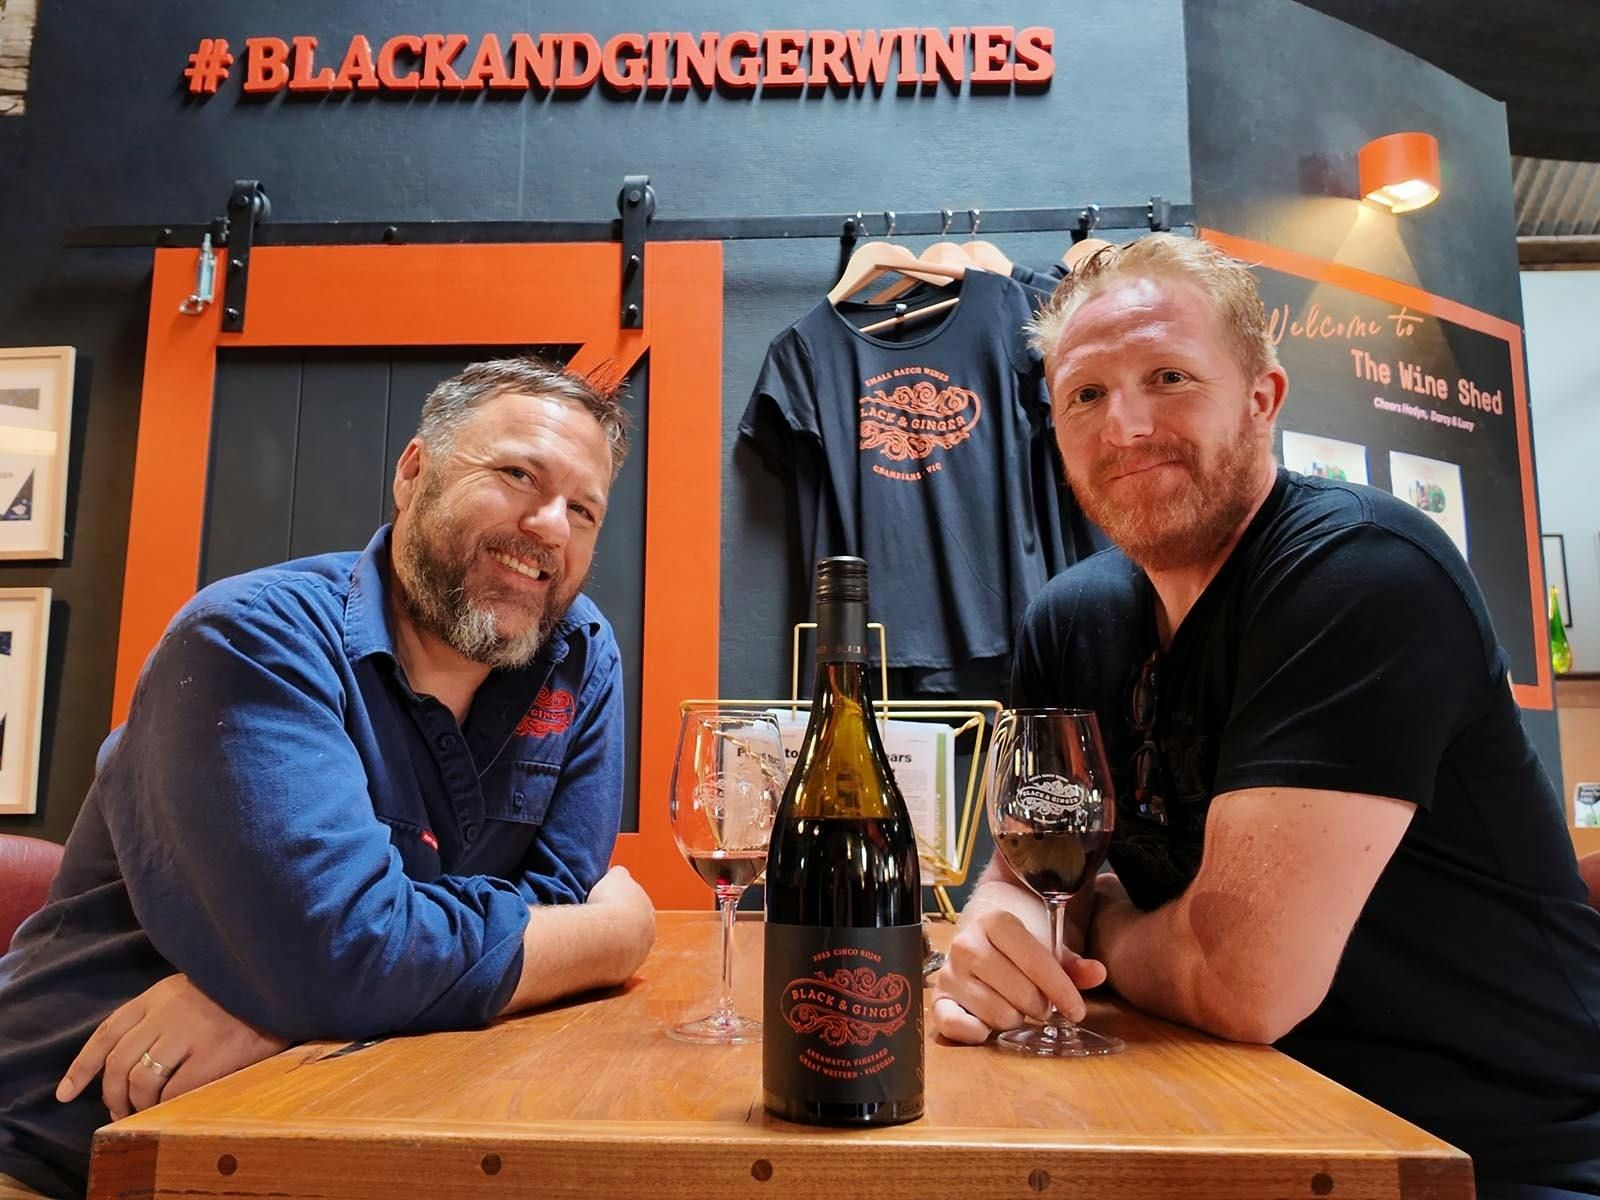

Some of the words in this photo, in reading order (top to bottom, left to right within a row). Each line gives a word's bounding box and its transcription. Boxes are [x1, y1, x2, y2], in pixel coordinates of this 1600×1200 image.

[1388, 306, 1424, 337] to
[865, 371, 892, 387] SMALL
[894, 367, 922, 377] BATCH
[924, 368, 949, 382] WINES
[1351, 349, 1391, 384] The
[1399, 360, 1448, 400] Wine
[1458, 378, 1503, 415] Shed
[1374, 396, 1401, 413] Cheers
[860, 407, 896, 422] LACK
[898, 416, 908, 427] &
[911, 416, 966, 431] GINGER
[926, 462, 942, 473] VIC
[785, 748, 799, 759] to
[833, 948, 858, 957] CINCO
[791, 988, 835, 1007] BLACK
[838, 999, 848, 1011] &
[852, 1003, 902, 1018] GINGER
[799, 1054, 821, 1072] GREAT
[823, 1067, 858, 1079] WESTERN
[864, 1055, 896, 1075] VICTORIA
[853, 1047, 888, 1066] VINEYARD
